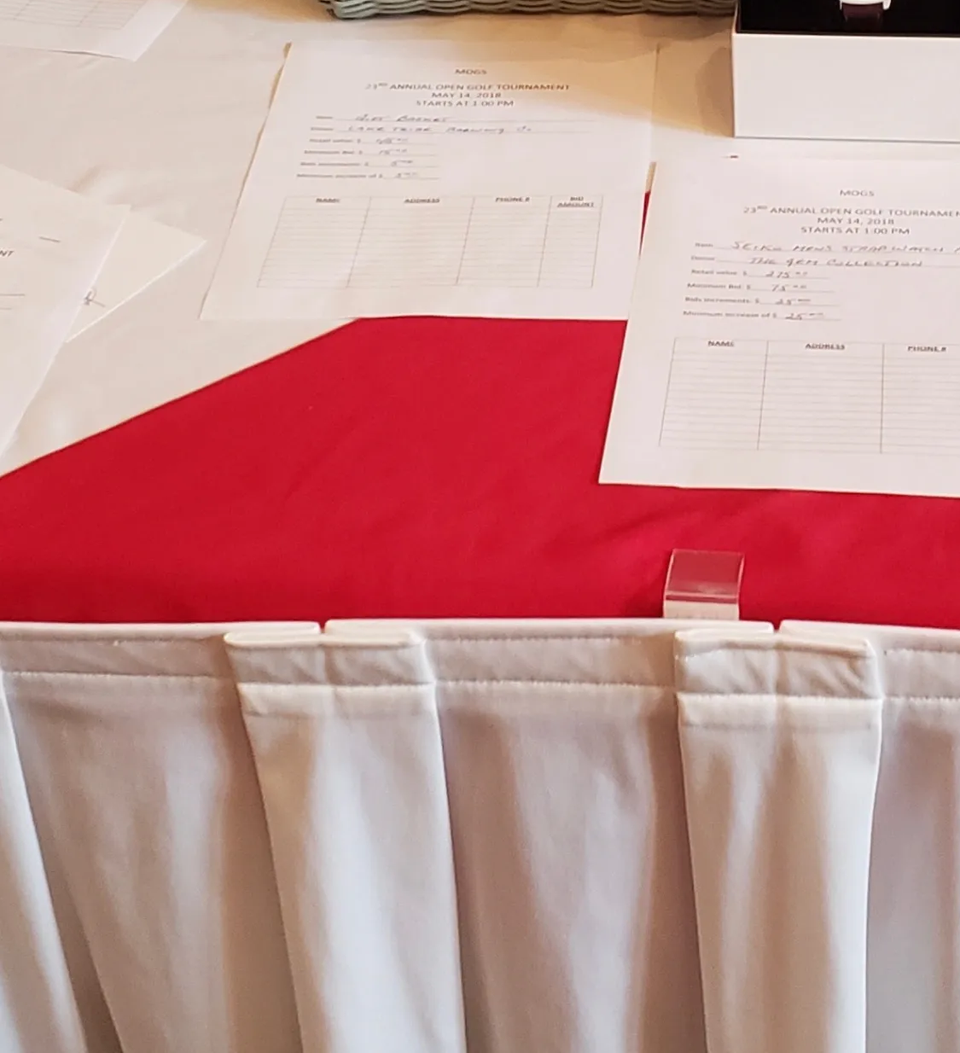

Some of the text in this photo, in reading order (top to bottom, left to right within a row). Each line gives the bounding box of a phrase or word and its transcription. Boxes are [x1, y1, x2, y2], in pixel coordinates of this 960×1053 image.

[496, 83, 570, 91] TOURNAMENT
[416, 99, 453, 107] STARTS
[839, 189, 875, 197] MOGS
[769, 207, 817, 215] ANNUAL
[820, 207, 852, 215] OPEN
[854, 208, 883, 216] GOLF
[817, 217, 843, 225] MAY
[867, 218, 895, 226] 2018
[800, 226, 843, 235] STARTS
[845, 227, 860, 235] AT
[891, 227, 911, 236] PM
[707, 340, 735, 348] NAME
[805, 342, 846, 351] ADDRESS
